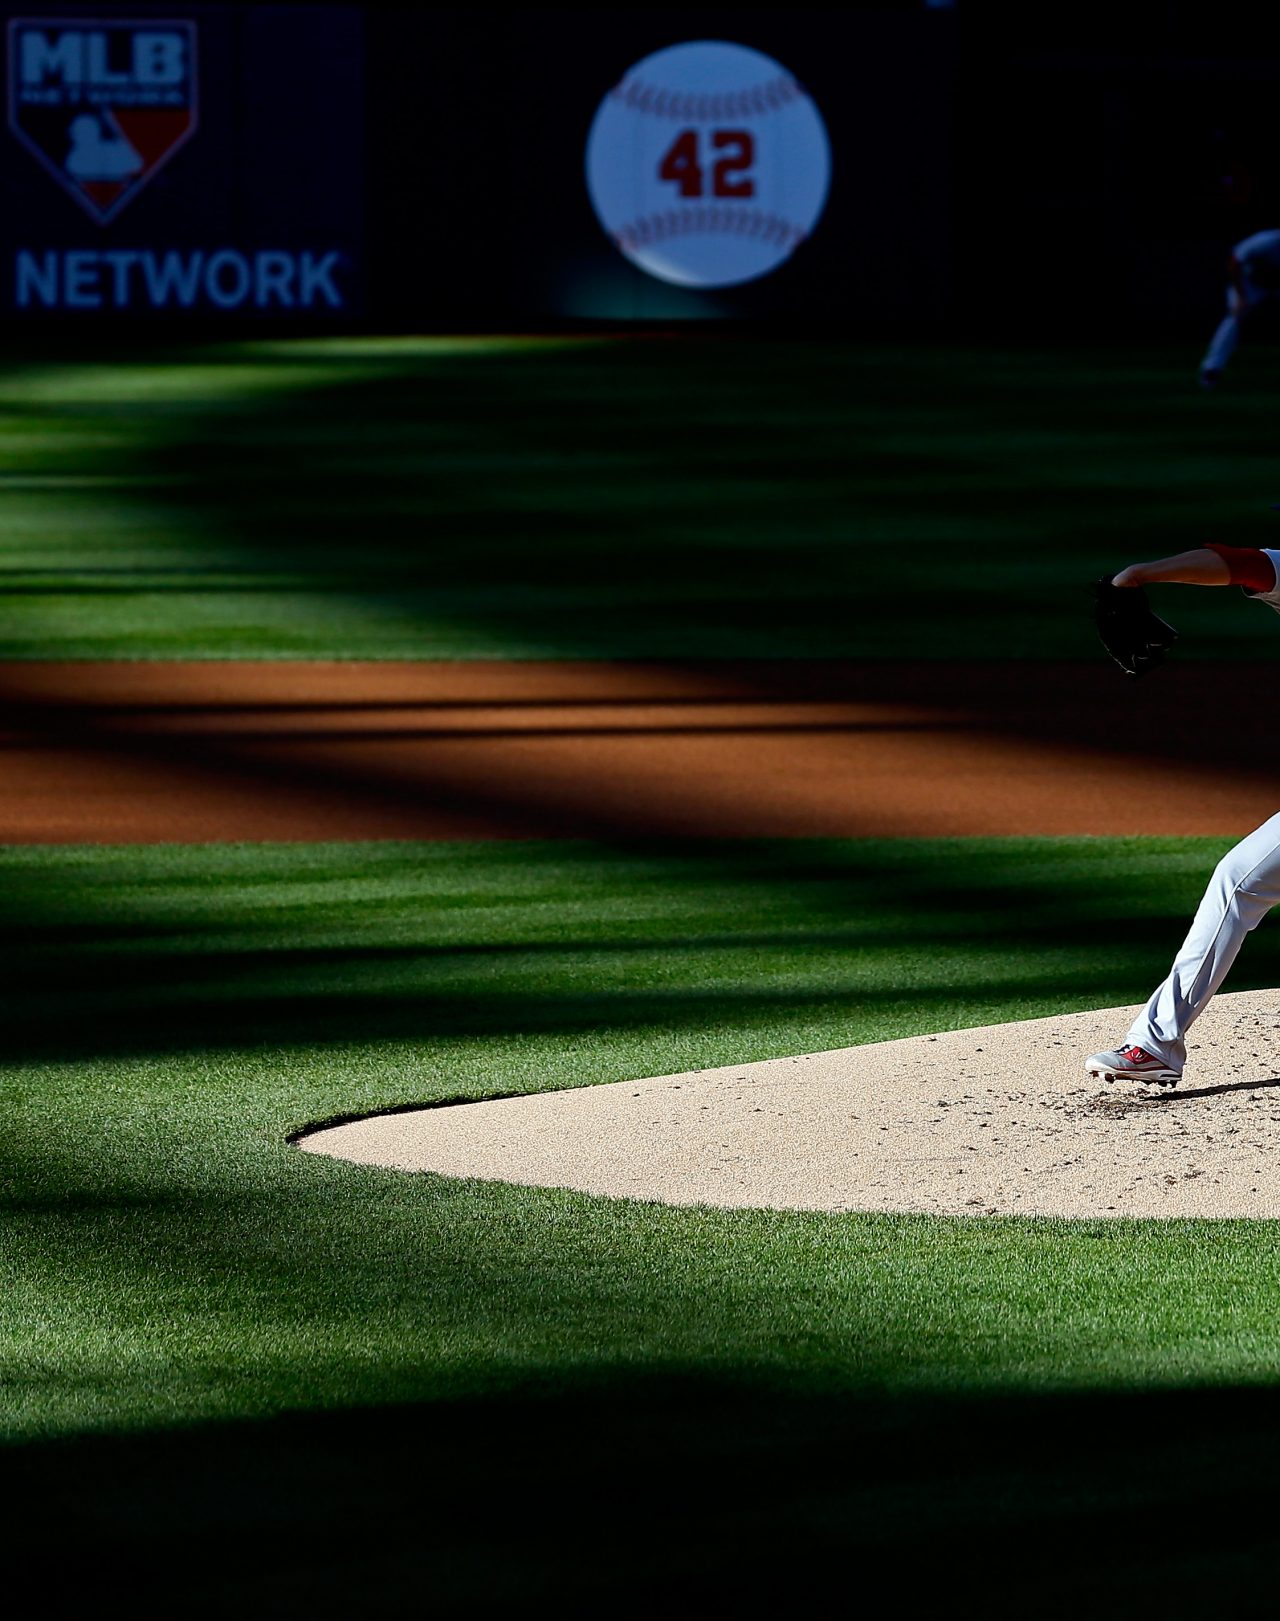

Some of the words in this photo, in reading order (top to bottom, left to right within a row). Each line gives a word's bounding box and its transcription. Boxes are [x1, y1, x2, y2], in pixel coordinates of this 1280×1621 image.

[21, 32, 184, 83] MLB
[660, 131, 754, 197] 42
[16, 250, 342, 309] NETWORK
